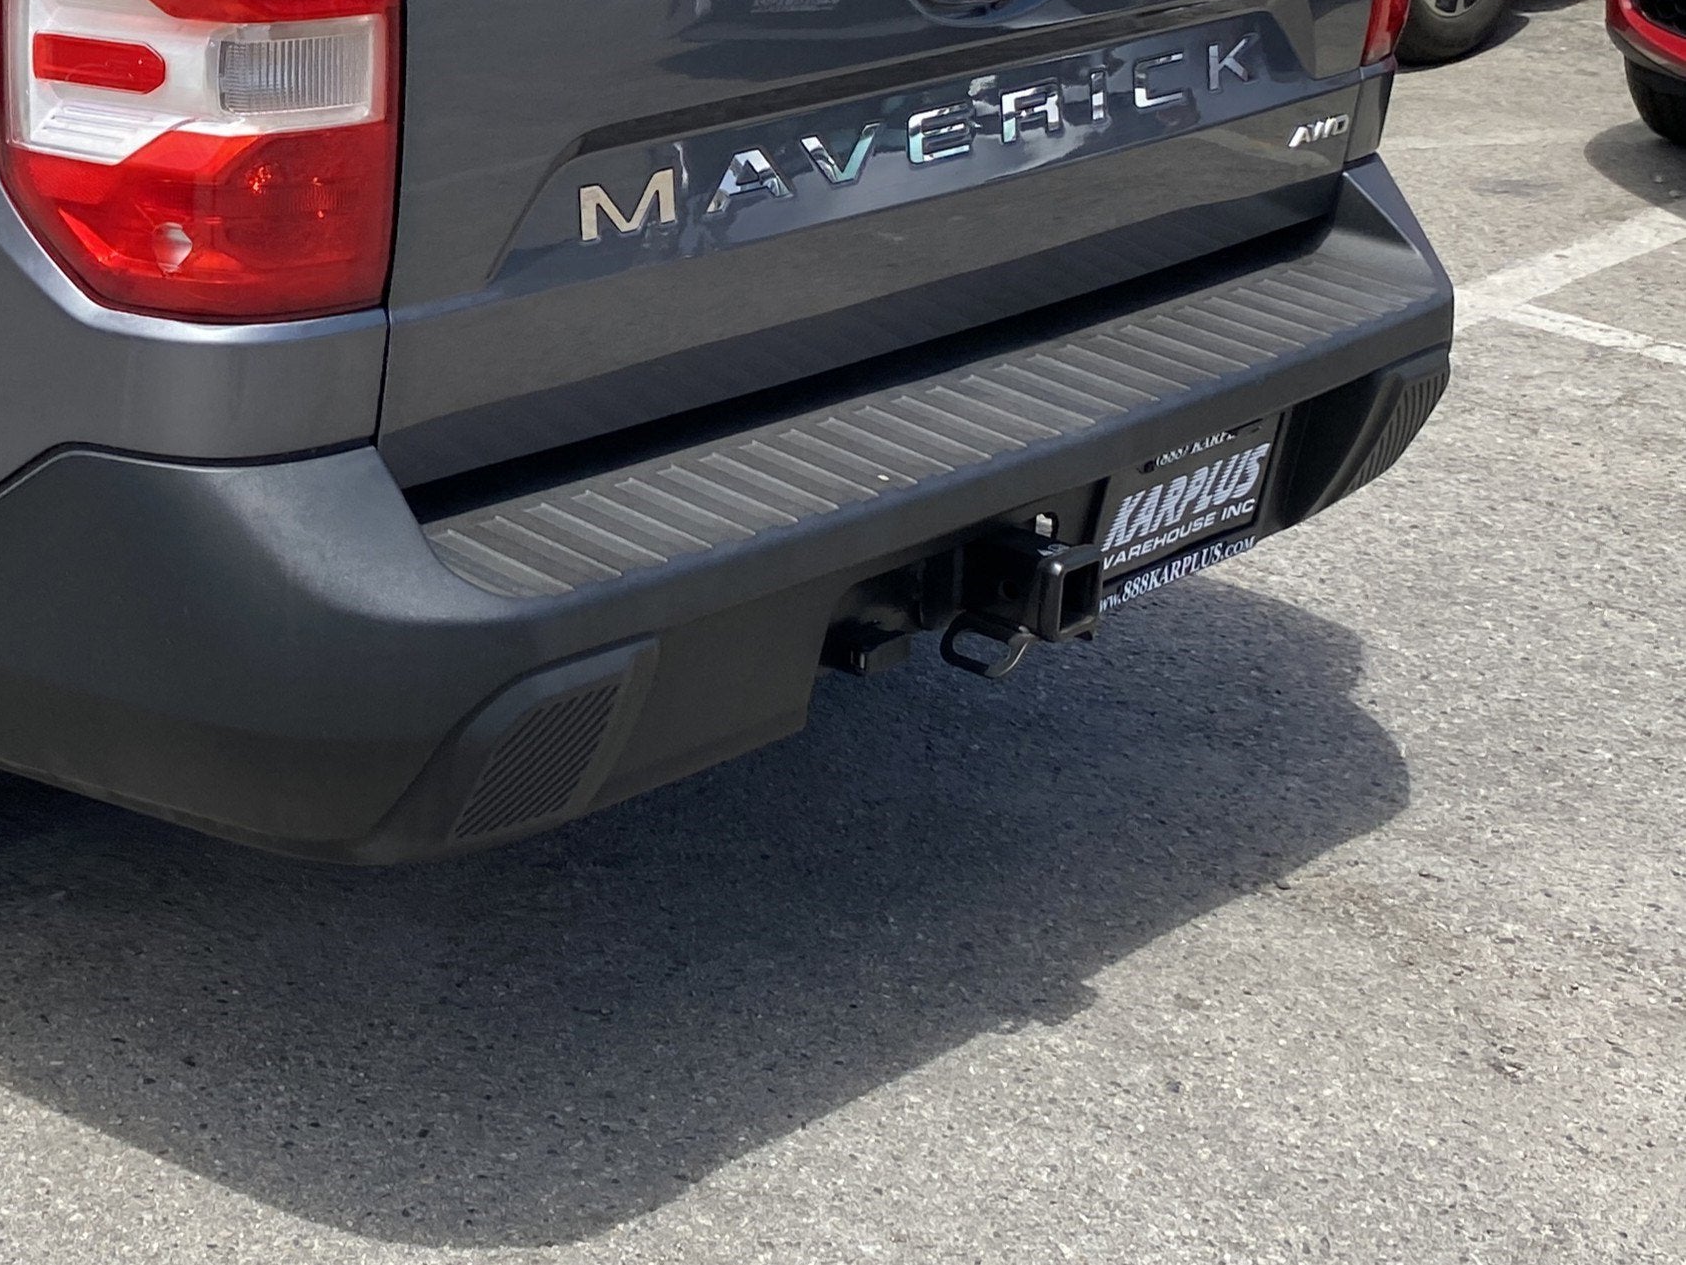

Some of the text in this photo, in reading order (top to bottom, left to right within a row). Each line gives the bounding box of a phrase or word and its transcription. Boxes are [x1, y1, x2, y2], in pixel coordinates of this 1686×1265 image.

[578, 32, 1259, 243] MAVERICK
[1288, 114, 1349, 148] AWD
[1101, 442, 1271, 552] KARPLUS
[1221, 498, 1256, 521] INC
